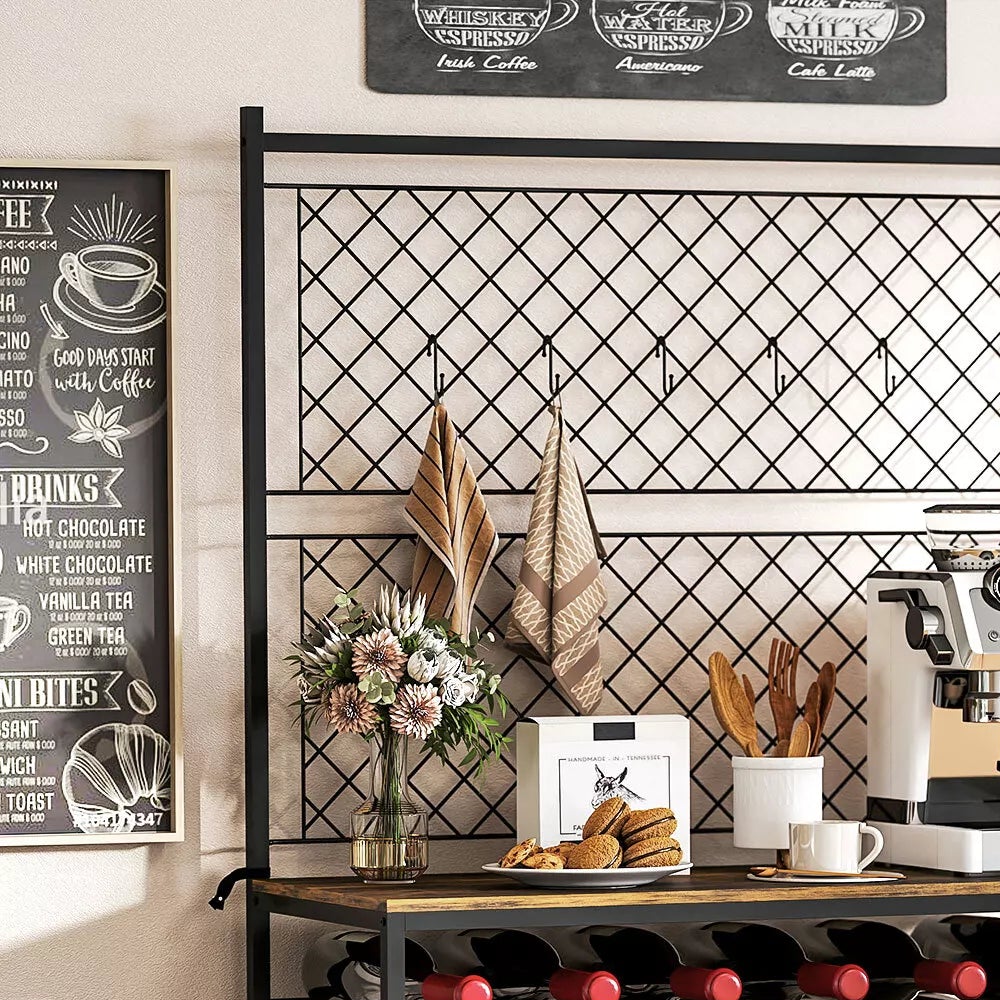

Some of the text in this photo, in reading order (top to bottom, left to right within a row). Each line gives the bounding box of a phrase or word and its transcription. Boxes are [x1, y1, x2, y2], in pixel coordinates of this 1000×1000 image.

[420, 8, 547, 28] WHISKEY
[621, 1, 688, 18] Hot
[600, 15, 714, 33] WATER
[784, 22, 877, 38] MILK
[433, 29, 531, 47] ESPRESSO
[611, 33, 705, 51] ESPRESSO
[786, 39, 878, 56] ESPRESSO
[436, 54, 538, 70] Irish Coffee
[615, 56, 704, 72] Americano
[787, 62, 877, 78] Cafe Latte
[54, 347, 155, 368] GOOD DAYS START
[55, 367, 155, 398] with Coffee
[12, 473, 99, 503] DRINKS
[23, 518, 146, 537] HOT CHOCOLATE
[16, 555, 153, 574] WHITE CHOCOLATE
[39, 592, 133, 610] VANILLA TEA
[50, 627, 125, 646] GREEN TEA
[31, 677, 98, 707] BITES
[0, 755, 36, 775] WICH
[6, 792, 55, 811] TOAST
